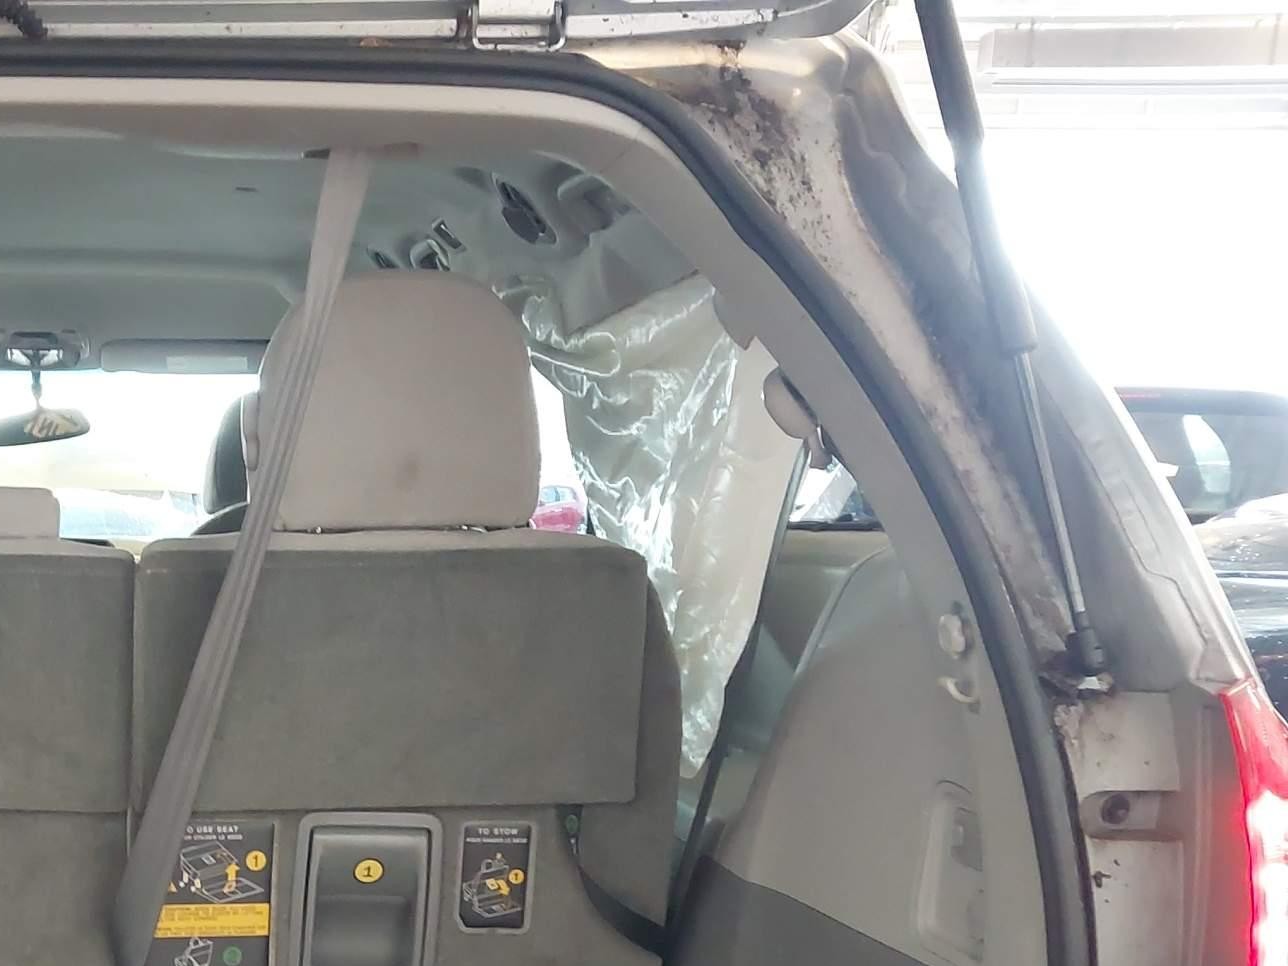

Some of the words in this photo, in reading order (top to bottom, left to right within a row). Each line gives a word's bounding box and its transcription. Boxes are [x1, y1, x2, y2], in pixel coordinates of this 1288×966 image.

[196, 825, 213, 833] USE
[216, 825, 239, 833] SEAT
[362, 865, 373, 877] 1
